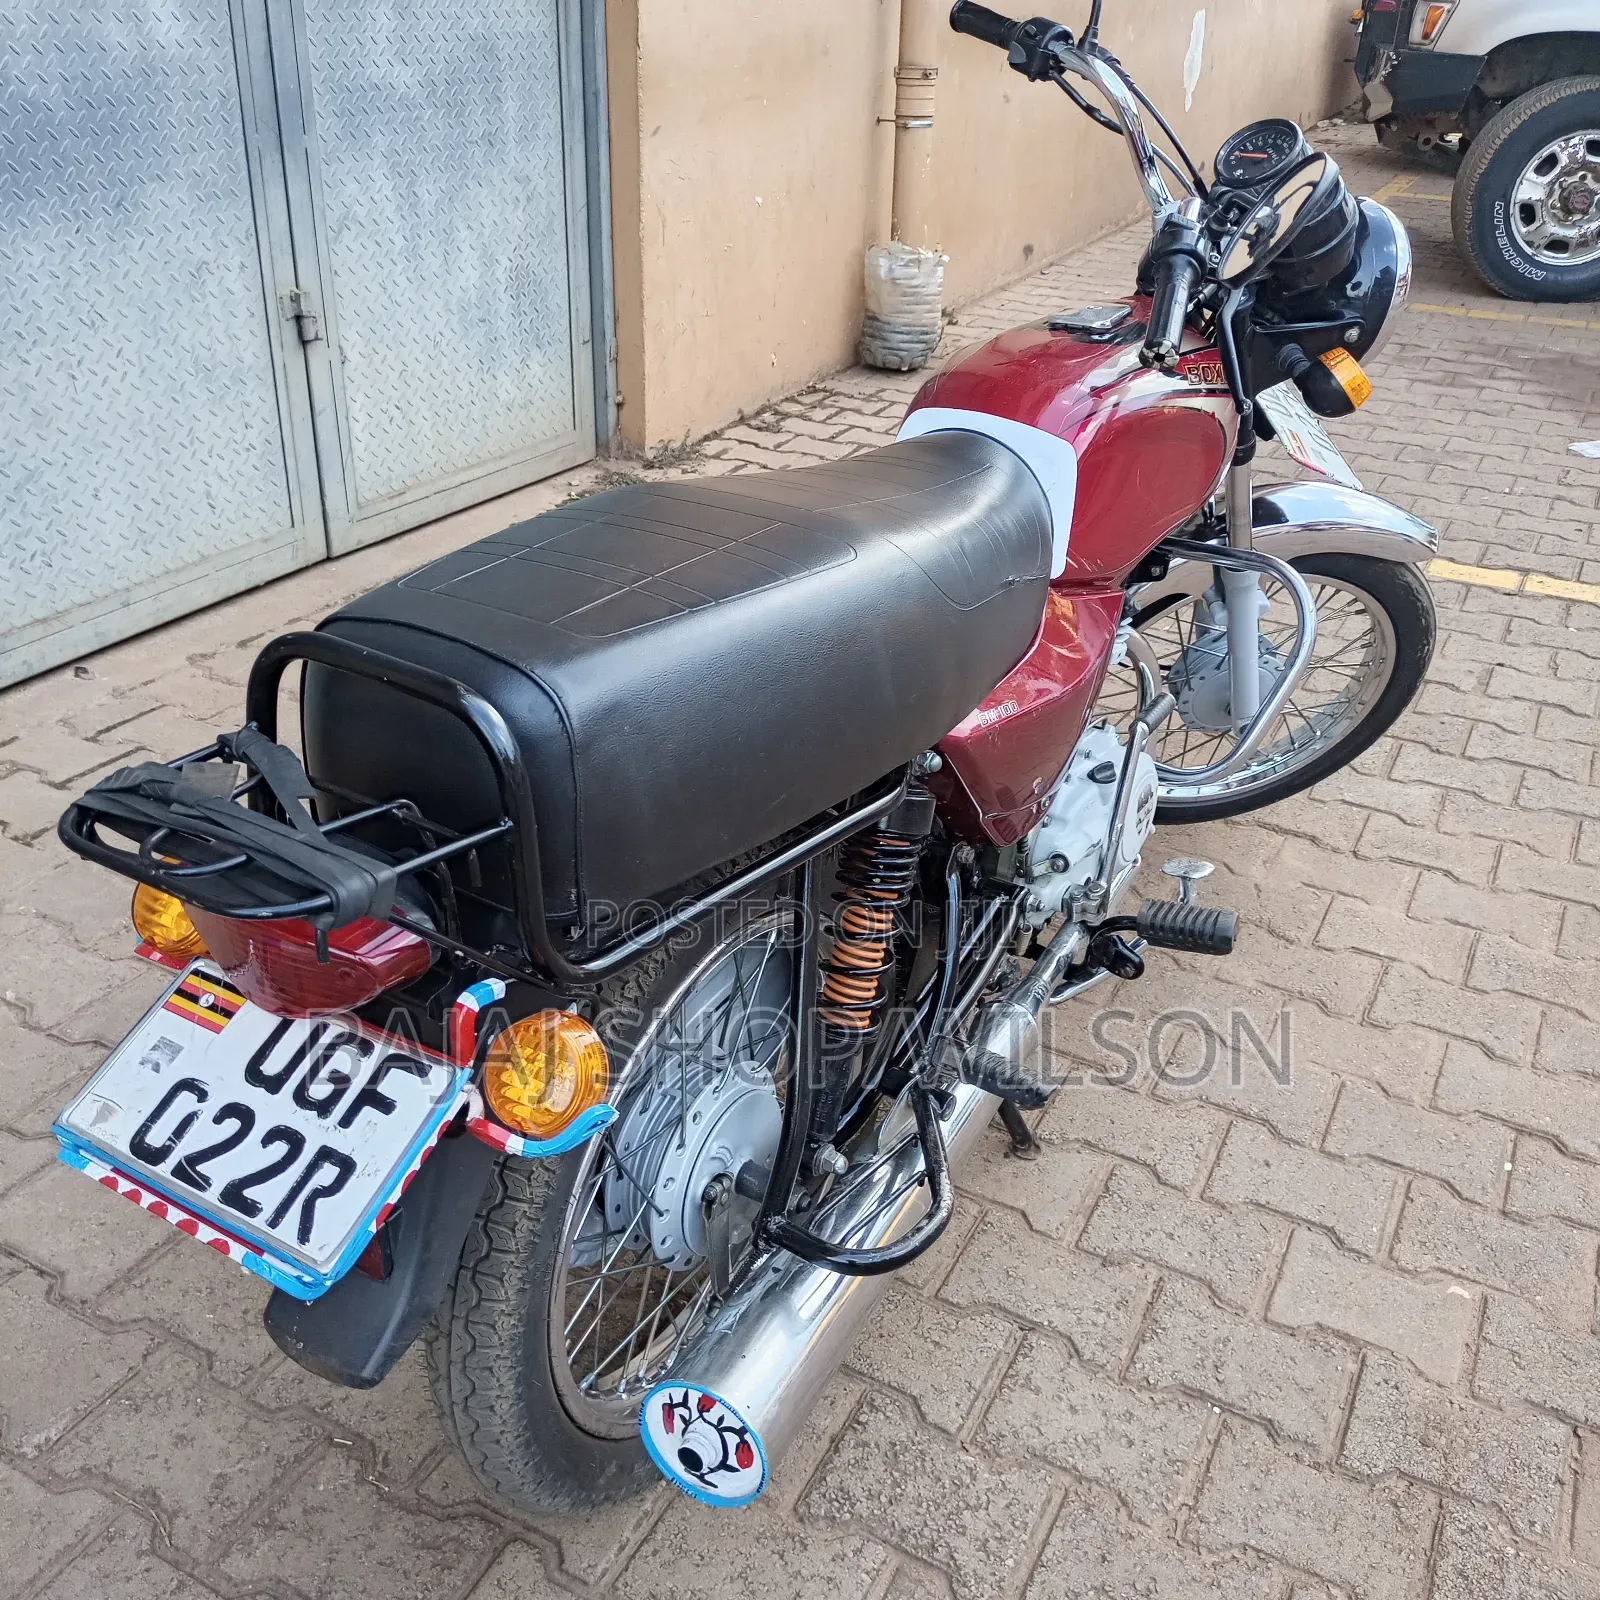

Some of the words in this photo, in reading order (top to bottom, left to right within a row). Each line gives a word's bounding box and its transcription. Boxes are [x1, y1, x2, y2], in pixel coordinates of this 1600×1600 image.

[1494, 201, 1547, 281] MICHELIN
[1184, 361, 1228, 385] BOX
[977, 708, 999, 728] BM
[998, 699, 1020, 719] 100
[245, 1018, 433, 1129] UGF
[129, 1077, 358, 1246] 022R
